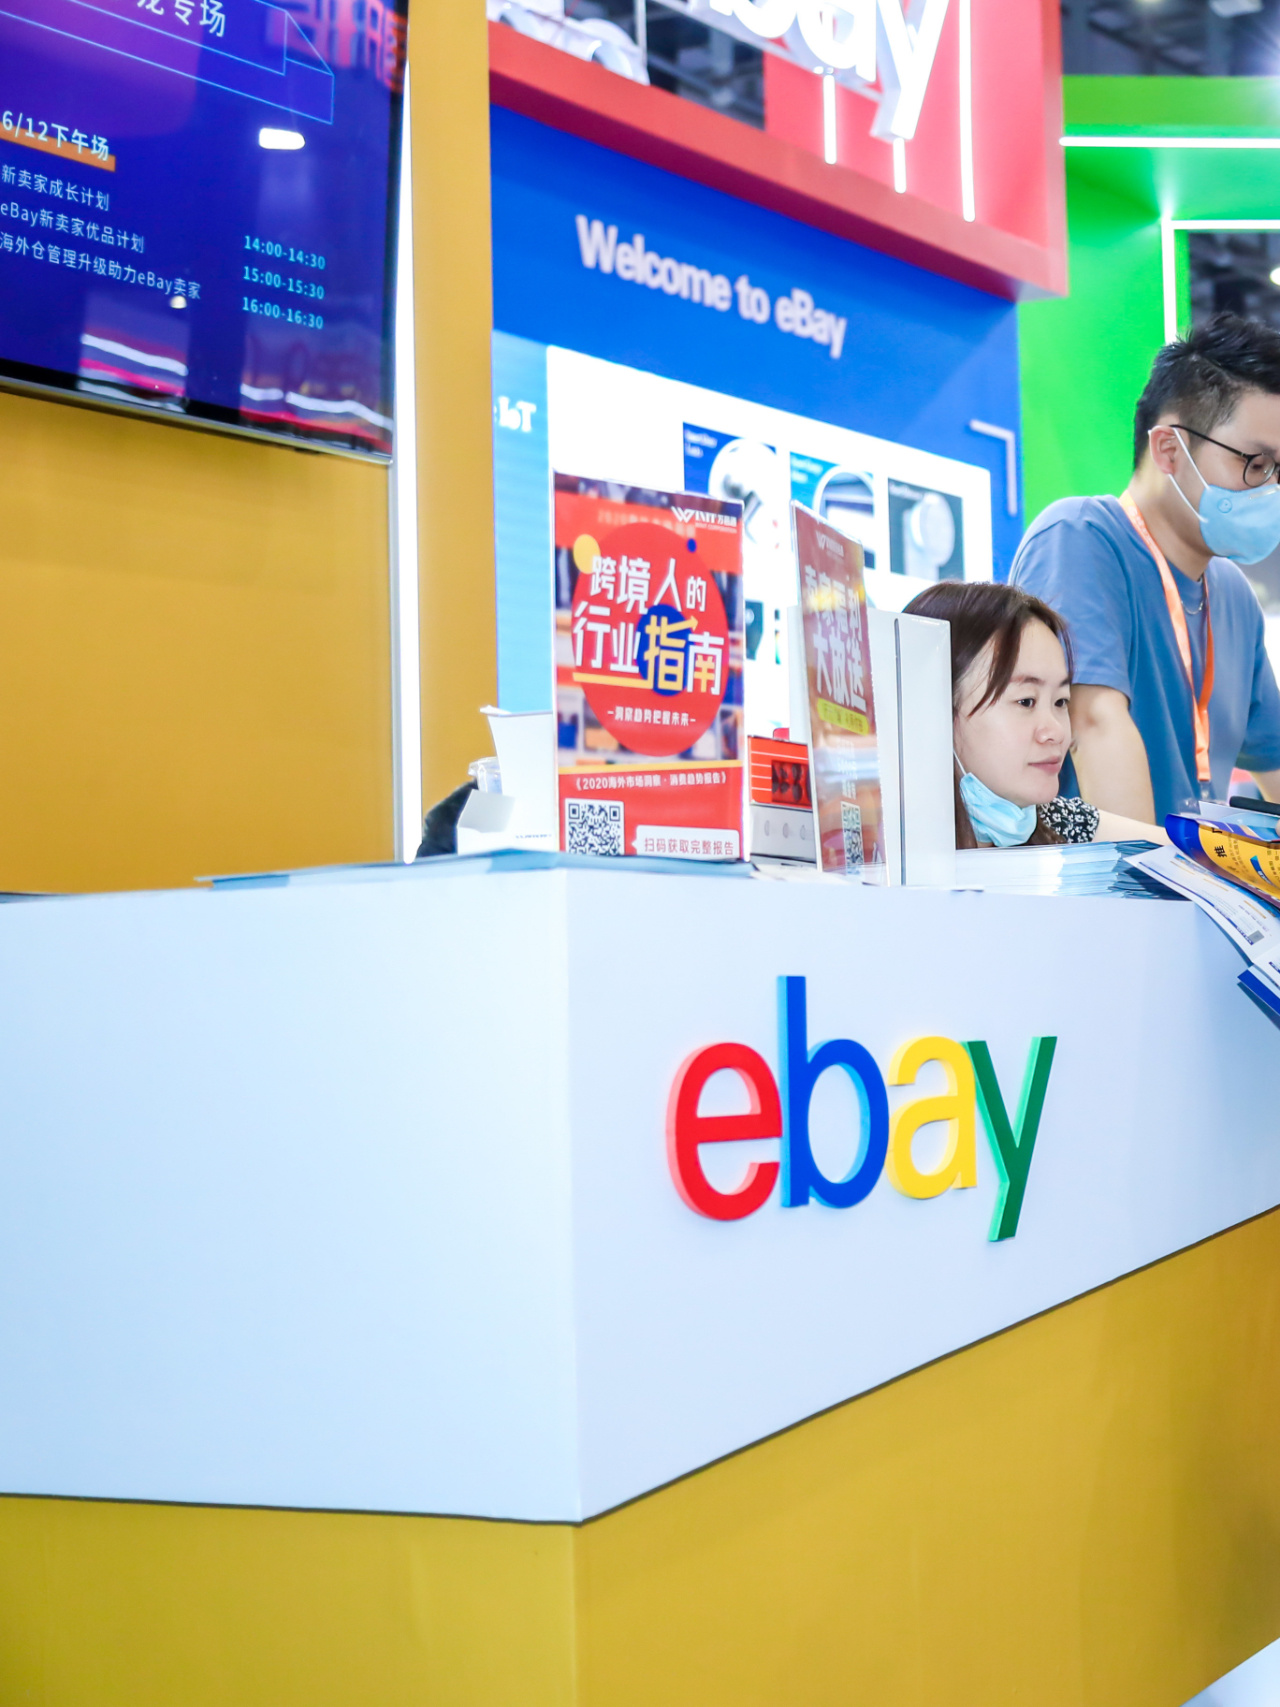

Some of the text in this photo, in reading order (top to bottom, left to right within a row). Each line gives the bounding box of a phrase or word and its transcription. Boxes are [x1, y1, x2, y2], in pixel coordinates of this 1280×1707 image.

[2, 110, 109, 162] 6/12下午场
[1, 164, 110, 212] 新卖家成长计划
[0, 202, 144, 254] eBay新卖家优品计划
[244, 235, 326, 270] 14:00-14:30
[0, 231, 201, 300] 海外仓管理升级助力eBay卖家
[243, 266, 325, 300] 15:00-15:30
[576, 214, 848, 360] Welcome to eBay
[242, 296, 324, 330] 16:00-16:30
[590, 555, 707, 615] 跨境人的
[573, 601, 725, 696] 行业指南
[644, 838, 734, 856] 扫码获取完整报告
[666, 975, 1058, 1242] ebay
